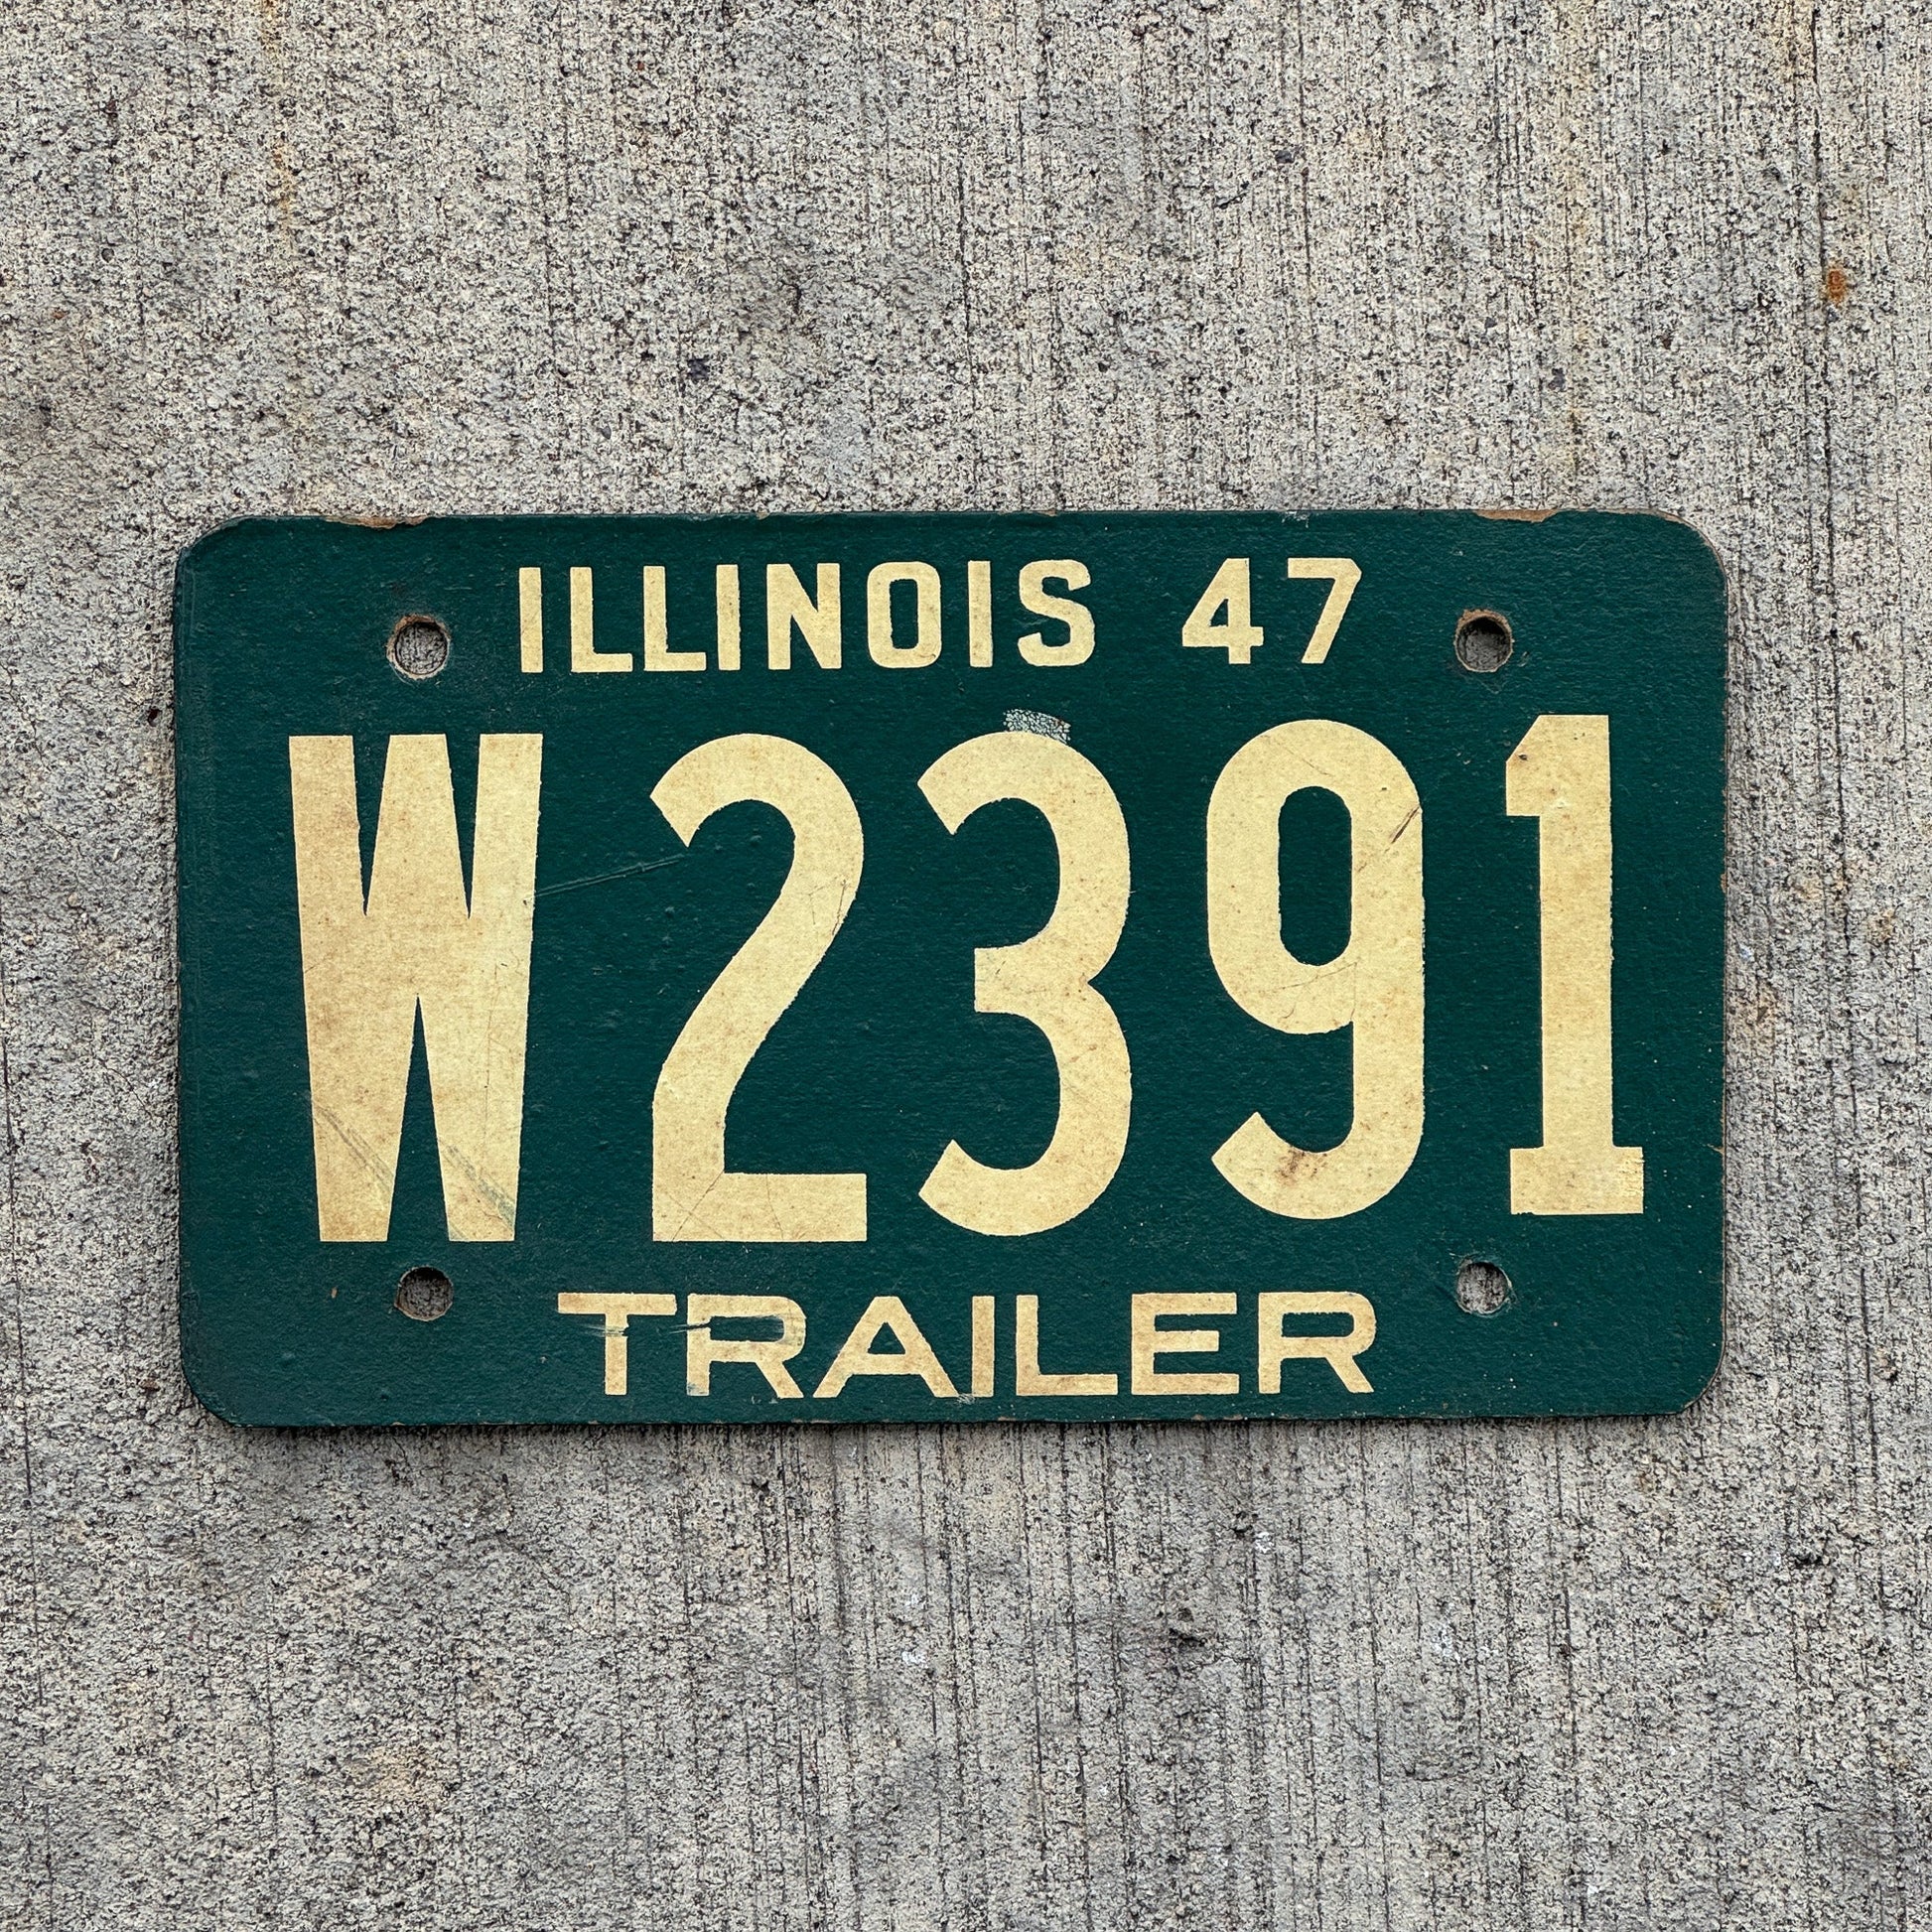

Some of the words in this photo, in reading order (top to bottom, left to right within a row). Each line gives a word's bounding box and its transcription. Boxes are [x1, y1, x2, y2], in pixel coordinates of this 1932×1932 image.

[518, 558, 1095, 674] ILLINOIS
[1181, 557, 1362, 665] 47
[557, 1291, 1377, 1399] TRAILER
